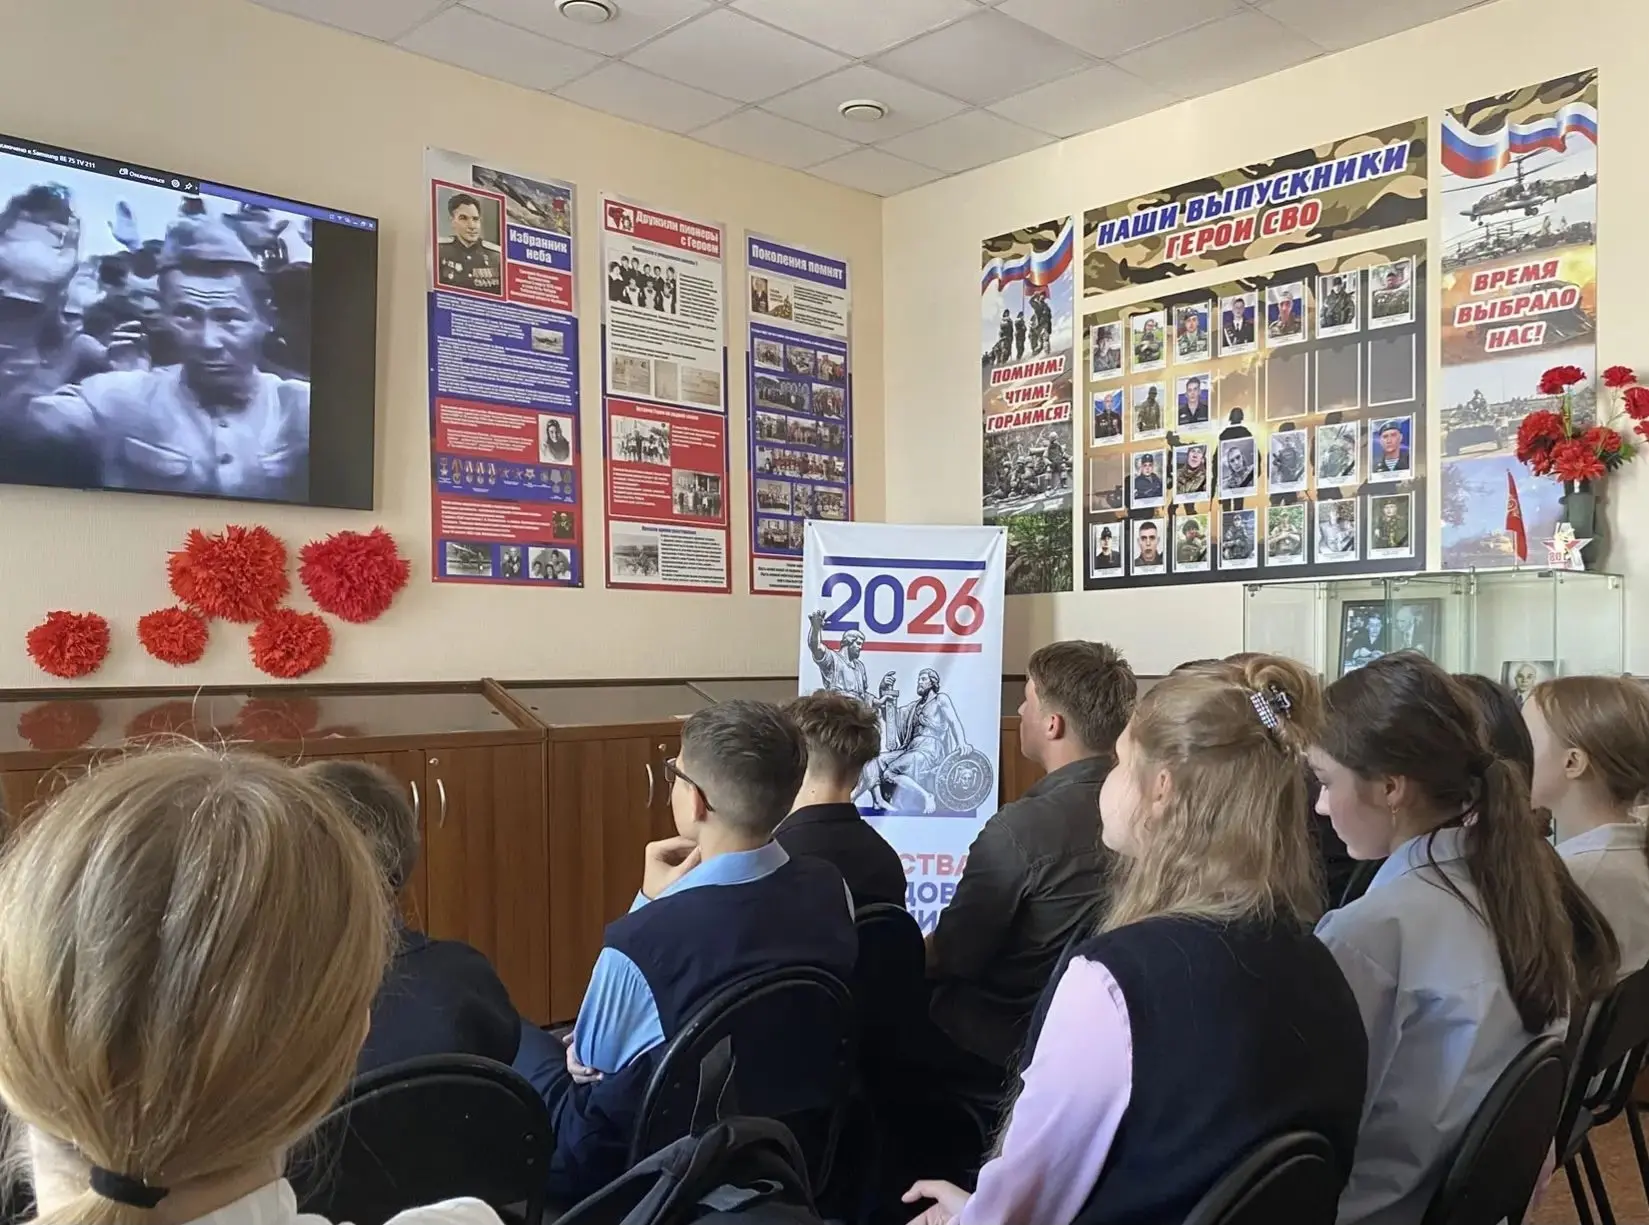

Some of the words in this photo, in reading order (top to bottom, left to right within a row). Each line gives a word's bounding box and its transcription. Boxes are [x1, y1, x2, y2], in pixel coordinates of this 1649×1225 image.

[32, 149, 59, 162] Samsung
[76, 159, 85, 167] TV
[85, 160, 96, 169] 211
[1098, 205, 1179, 246] НАШИ
[1186, 144, 1409, 223] ВЫПУСКНИКИ
[636, 210, 678, 232] Дружили
[679, 223, 719, 242] пионеры
[1165, 217, 1254, 260] ГЕРОИ
[1262, 202, 1321, 236] СВО
[509, 228, 568, 254] Избранник
[680, 236, 687, 246] с
[687, 236, 719, 255] Героем
[525, 248, 552, 264] неба
[751, 244, 807, 271] Поколения
[807, 260, 843, 280] помнят
[1473, 260, 1559, 292] ВРЕМЯ
[1457, 288, 1577, 325] ВЫБРАЛО
[1487, 324, 1544, 349] НАС!
[992, 358, 1064, 384] ПОМНИМ!
[1004, 383, 1051, 405] ЧТИМ!
[987, 404, 1069, 432] ГОРДИМСЯ!
[821, 572, 985, 636] 2026
